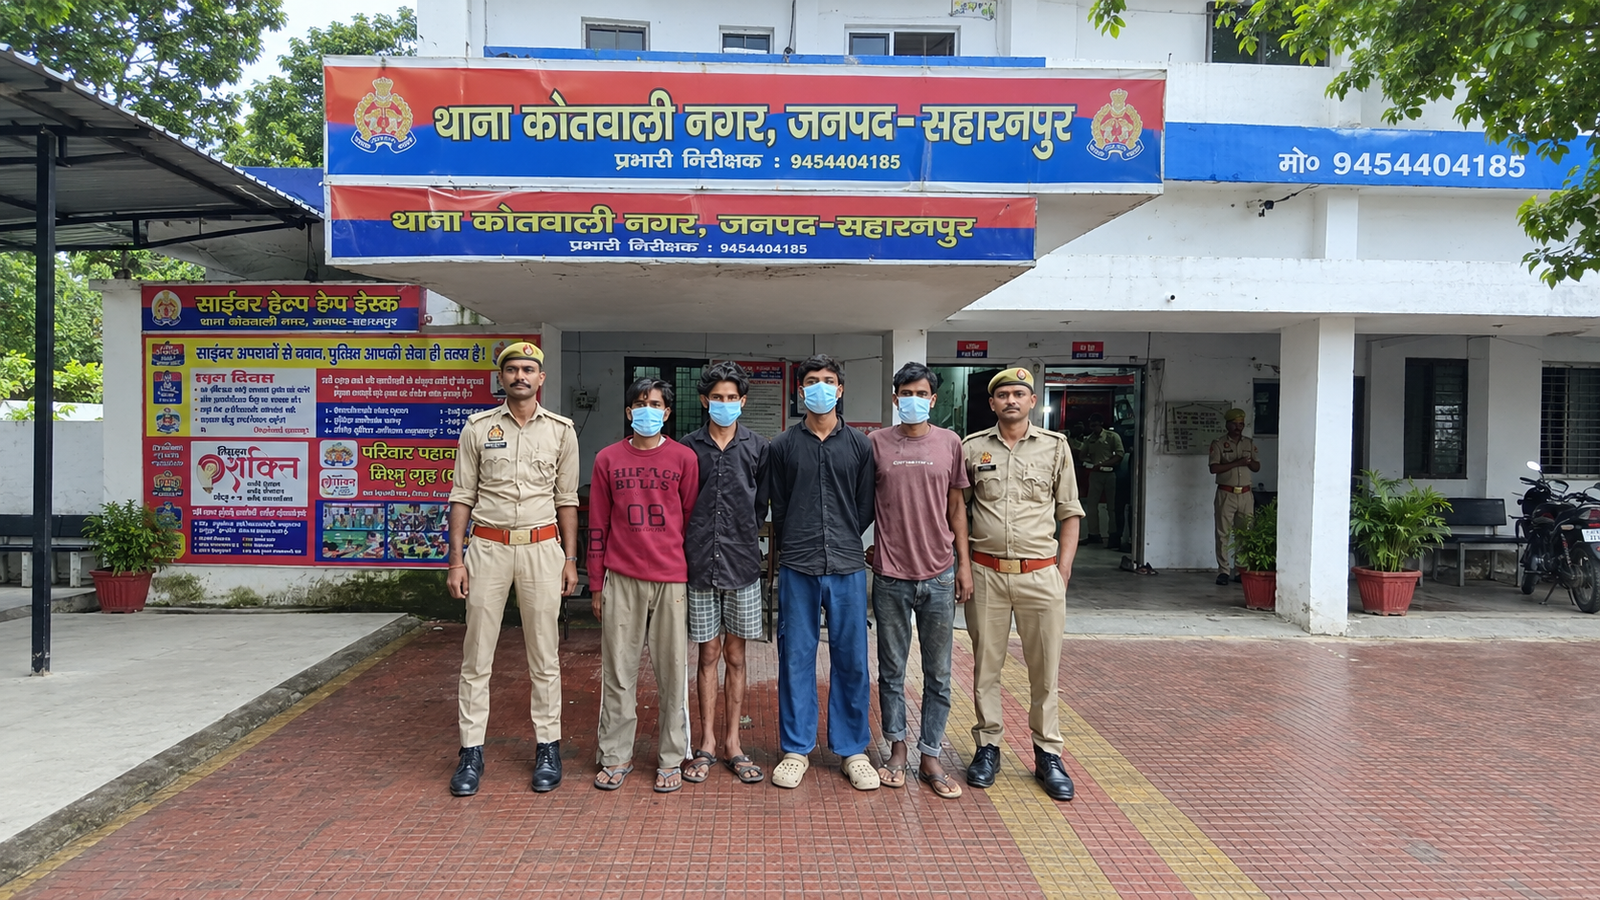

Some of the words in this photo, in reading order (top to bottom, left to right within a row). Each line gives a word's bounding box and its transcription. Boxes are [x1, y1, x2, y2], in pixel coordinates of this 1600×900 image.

[434, 103, 513, 143] थाना
[520, 87, 677, 144] कोतवाली
[684, 103, 776, 147] नगर,
[614, 147, 674, 171] प्रभारी
[682, 147, 763, 170] निरीक्षक
[790, 153, 901, 170] 9454404185
[1333, 152, 1526, 178] 9454404185
[390, 209, 463, 233] थाना
[471, 202, 616, 236] कोतवाली
[624, 212, 707, 238] नगर,
[569, 238, 620, 253] प्रभारी
[628, 238, 699, 253] निरीक्षक
[720, 243, 807, 254] 9454404185
[282, 342, 293, 360] से
[361, 441, 415, 459] परिवार
[627, 504, 665, 527] 08
